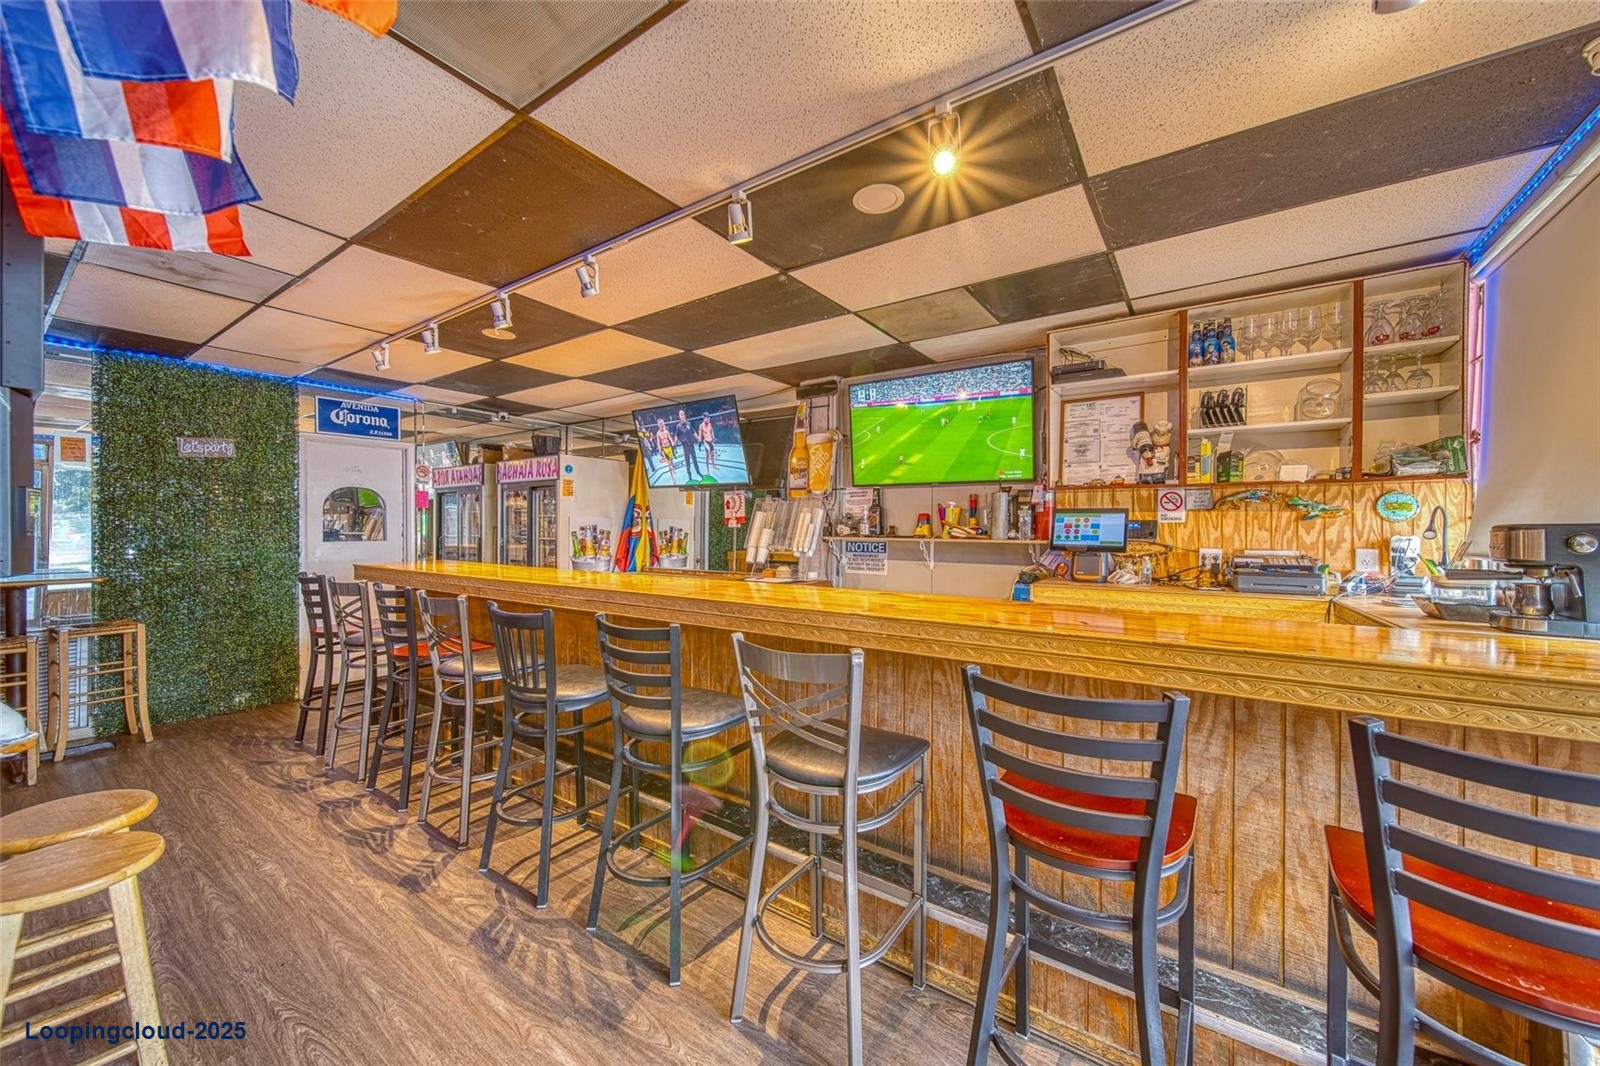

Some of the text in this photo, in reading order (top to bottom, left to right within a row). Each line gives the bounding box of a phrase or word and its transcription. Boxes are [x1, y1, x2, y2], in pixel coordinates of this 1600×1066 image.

[340, 402, 379, 412] AVENIDA
[330, 408, 391, 429] Corona
[535, 456, 558, 477] ROSA
[847, 542, 886, 553] NOTICE
